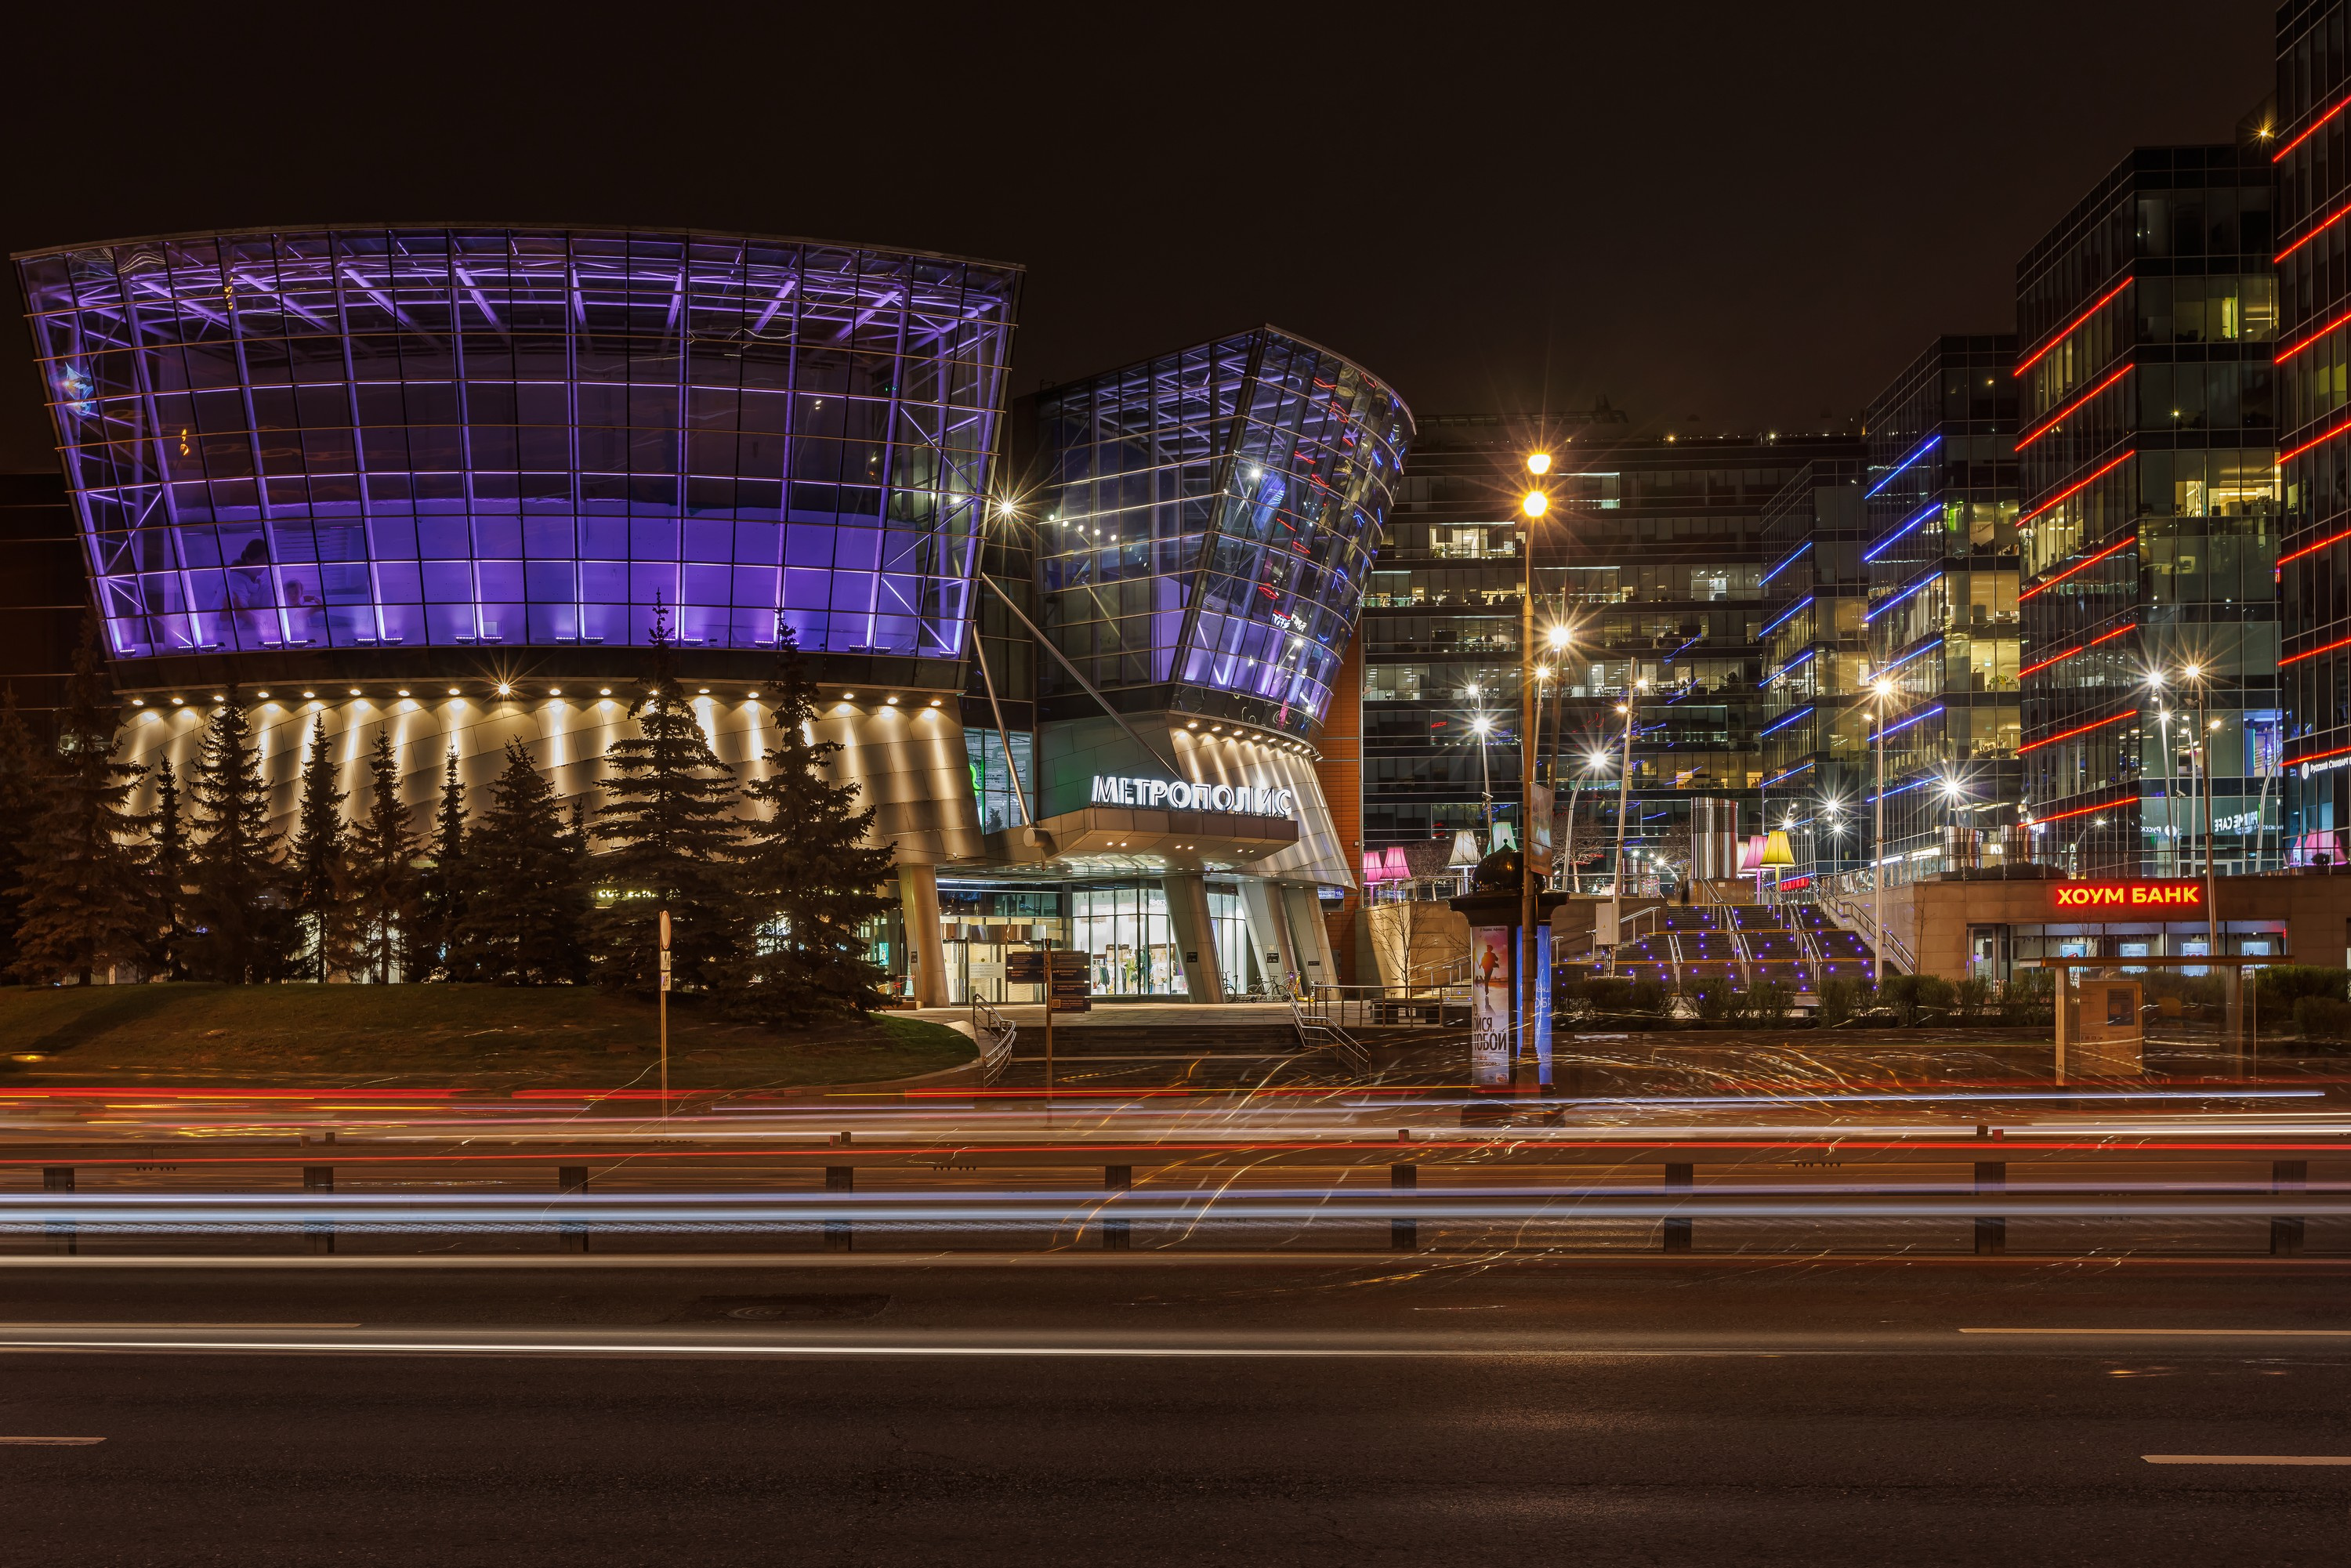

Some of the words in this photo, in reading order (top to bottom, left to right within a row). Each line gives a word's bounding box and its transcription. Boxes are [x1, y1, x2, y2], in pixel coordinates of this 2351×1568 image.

[1092, 775, 1292, 816] МЕТРОПОЛИС
[2057, 888, 2125, 904] ХОУМ
[2132, 886, 2199, 904] БАНК
